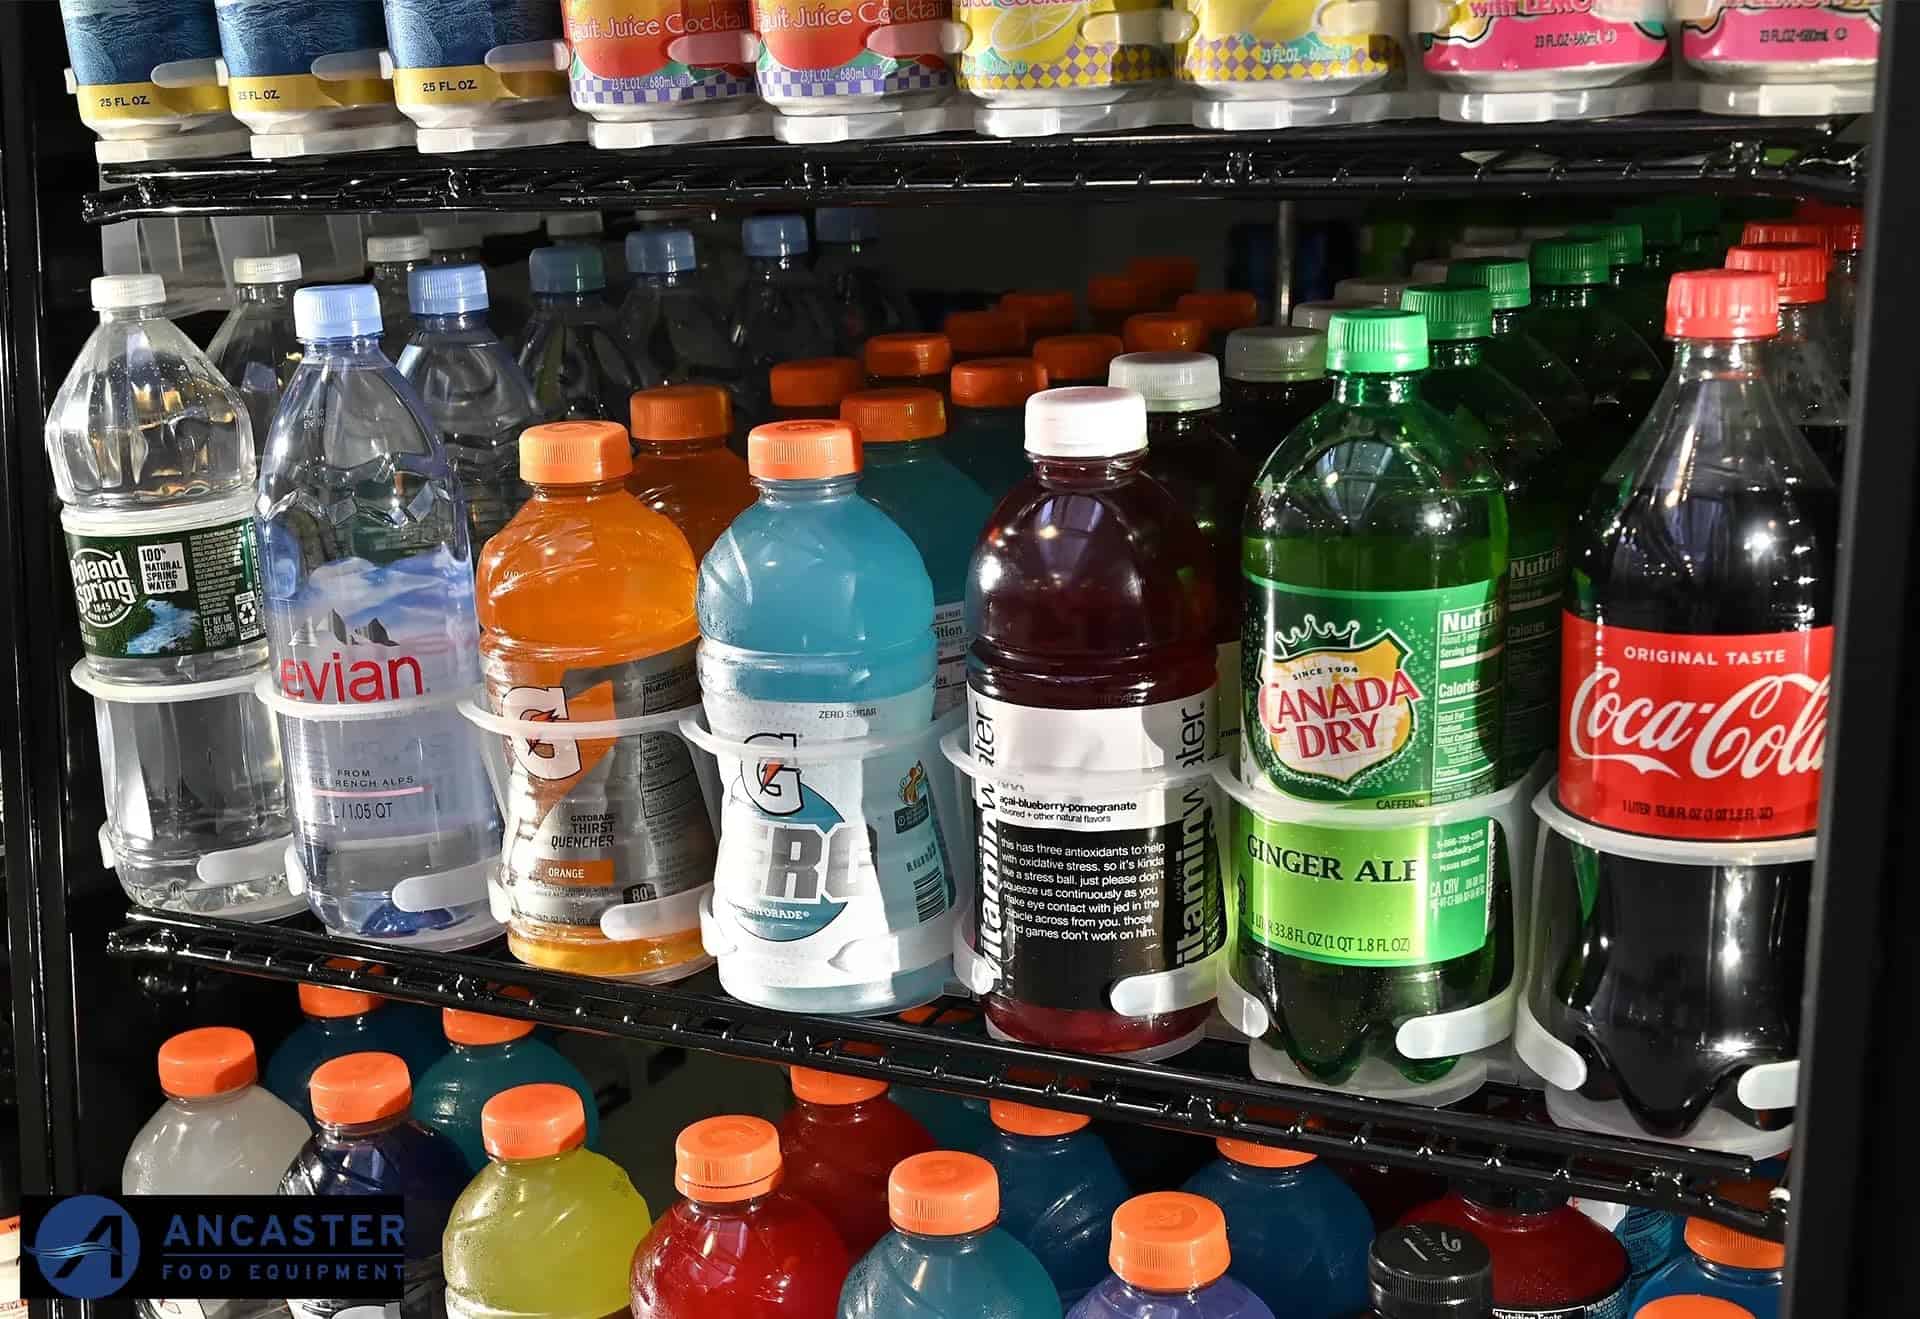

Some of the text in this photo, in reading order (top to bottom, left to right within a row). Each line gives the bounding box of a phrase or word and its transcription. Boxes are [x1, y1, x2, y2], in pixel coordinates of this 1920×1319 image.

[603, 15, 660, 38] Juice
[664, 2, 749, 34] Cocktail
[792, 4, 853, 27] Juice
[857, 0, 944, 25] Cocktail
[422, 82, 436, 92] 25
[99, 98, 112, 107] 25
[70, 550, 130, 588] Poland
[145, 560, 183, 572] NATURAL
[146, 571, 178, 581] SPRING
[147, 580, 178, 591] WATER
[75, 578, 137, 614] spring
[1622, 645, 1787, 667] ORIGINAL TASTE
[280, 652, 425, 704] evian
[1292, 665, 1360, 681] SINCE 1904
[818, 709, 845, 720] ZERO
[1295, 712, 1380, 760] DRY
[337, 768, 371, 778] FROM
[334, 778, 378, 789] RENCH
[382, 775, 415, 787] ALPS
[375, 801, 394, 819] QT
[1033, 811, 1055, 822] other
[1056, 813, 1083, 824] natural
[1084, 813, 1112, 824] flavors
[570, 821, 616, 834] THIRST
[550, 834, 615, 850] QUENCHER
[1001, 838, 1166, 858] this has three antioxidants to help
[1001, 852, 1165, 872] with oxidative stress. so it's kinda
[1247, 833, 1344, 881] GINGER
[548, 867, 586, 880] ORANGE
[1016, 870, 1023, 880] a
[1024, 871, 1056, 883] stress
[1056, 873, 1078, 885] ball.
[1079, 875, 1100, 888] just
[1101, 874, 1137, 887] please
[1138, 869, 1165, 883] don't
[1353, 859, 1419, 883] ALE
[631, 887, 649, 902] 80
[1040, 888, 1053, 898] us
[1055, 887, 1122, 902] continuously
[1123, 888, 1137, 898] as
[1139, 885, 1159, 899] you
[1004, 893, 1160, 915] make eye contact with jed in the
[1034, 913, 1070, 926] across
[1071, 916, 1096, 927] from
[1098, 918, 1121, 930] you.
[1123, 914, 1153, 926] those
[1025, 926, 1060, 940] games
[1061, 930, 1089, 941] don't
[1090, 930, 1118, 942] work
[1119, 930, 1134, 940] on
[1136, 926, 1158, 938] him.
[1274, 921, 1294, 941] 33.8
[1294, 928, 1307, 944] FL
[1307, 931, 1323, 948] OZ
[1324, 933, 1335, 950] (1
[1336, 935, 1356, 953] QT
[1357, 937, 1375, 953] 1.8
[1376, 938, 1390, 953] FL
